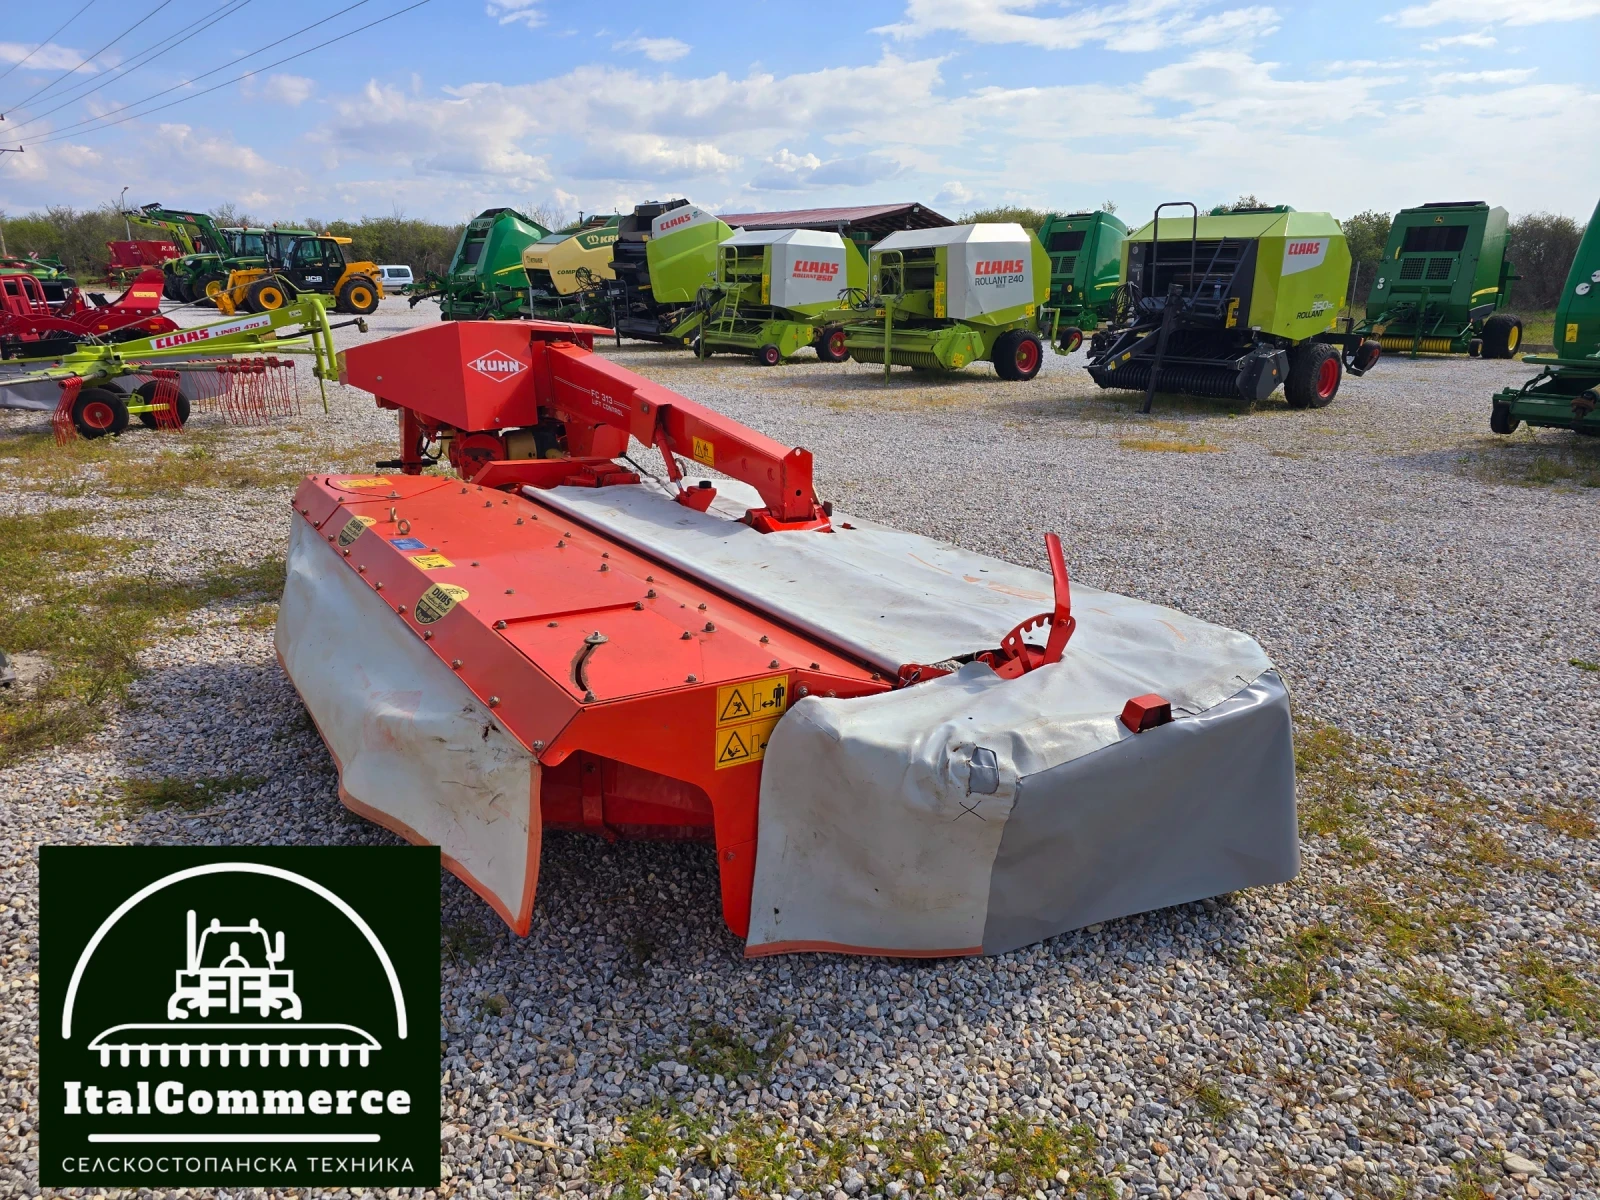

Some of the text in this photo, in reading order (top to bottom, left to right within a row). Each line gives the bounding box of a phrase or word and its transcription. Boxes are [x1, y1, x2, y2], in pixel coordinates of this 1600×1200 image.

[660, 213, 691, 231] CLAAS
[1288, 243, 1320, 255] CLAAS
[794, 260, 839, 274] CLAAS
[975, 259, 1024, 275] CLAAS
[975, 275, 1024, 286] ROLLANT 240
[1297, 310, 1324, 319] ROLLANT
[155, 328, 210, 350] CLAAS
[215, 326, 241, 337] LINER
[244, 322, 260, 331] 470
[476, 358, 520, 372] KUHN
[591, 389, 613, 405] FC 313
[431, 587, 453, 606] DUBS
